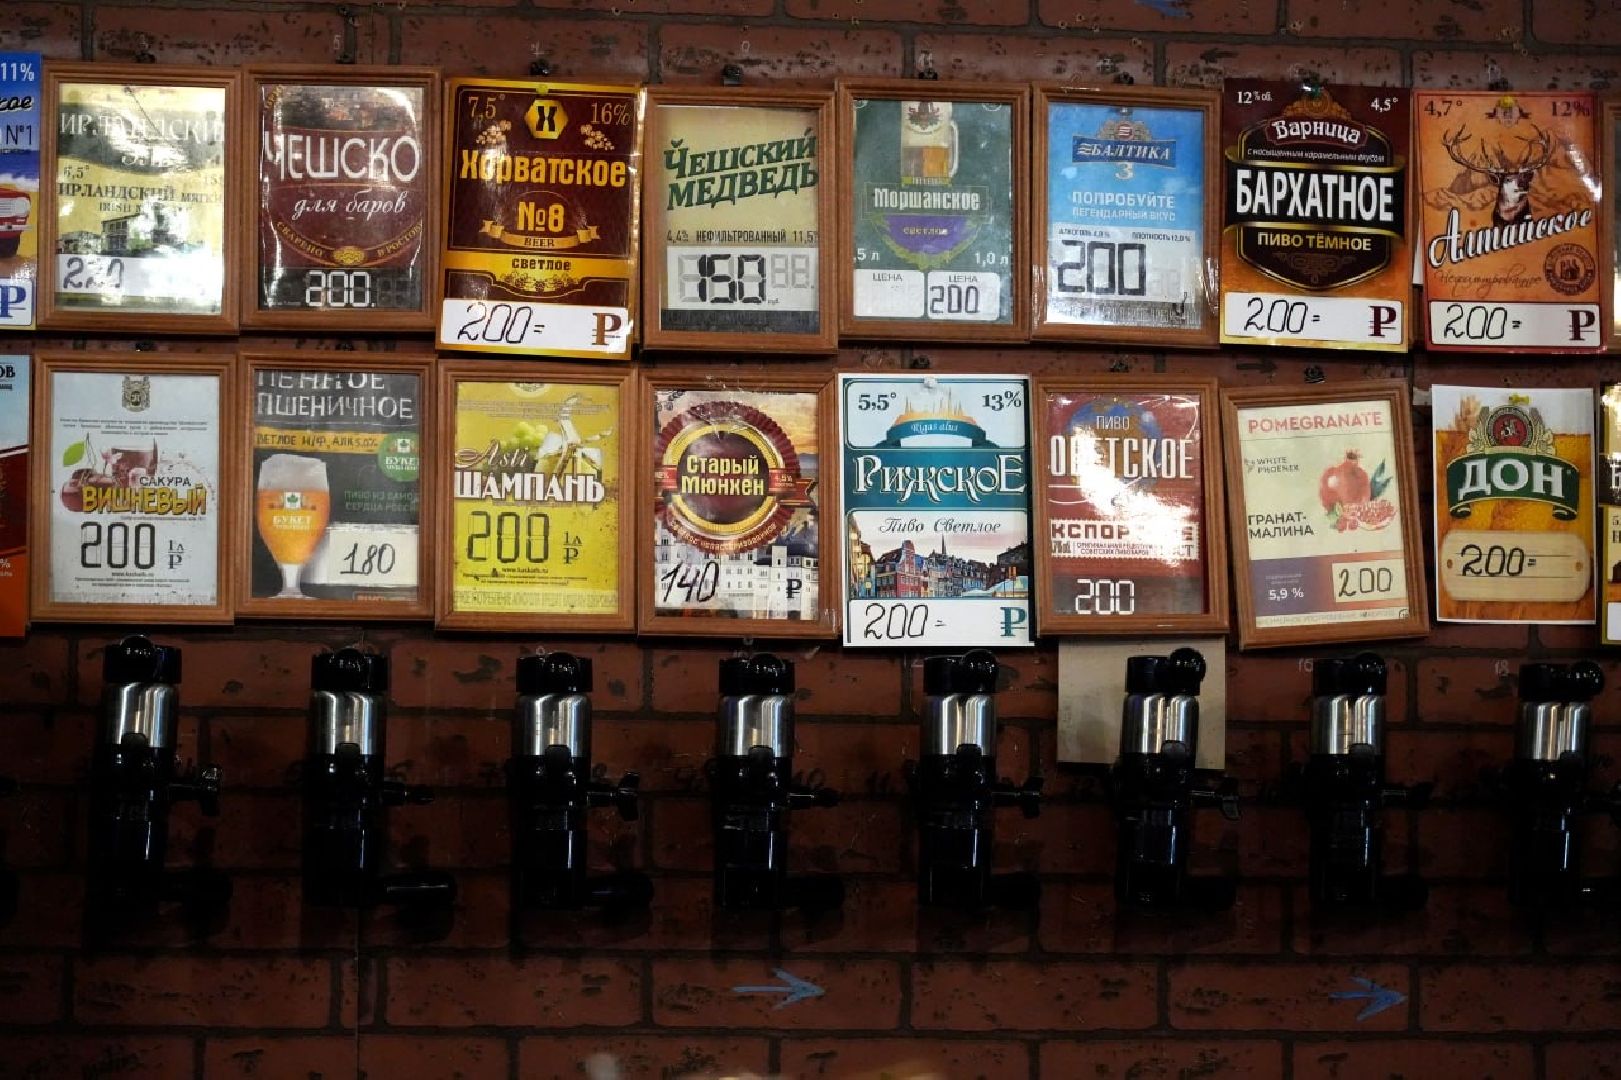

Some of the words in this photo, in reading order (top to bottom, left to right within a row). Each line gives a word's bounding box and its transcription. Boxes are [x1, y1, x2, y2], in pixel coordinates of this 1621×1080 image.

[590, 101, 632, 126] 16%
[1423, 100, 1463, 117] 4,7°
[1551, 101, 1590, 117] 12%
[1272, 119, 1361, 144] Варница
[1090, 144, 1170, 161] БАЛТИКА
[460, 149, 626, 188] Хорватское
[1115, 162, 1135, 180] 3
[666, 162, 819, 211] МЕДВЕДЬ
[1236, 169, 1394, 222] БАРХАТНОЕ
[291, 198, 338, 221] для
[345, 190, 408, 222] баров
[874, 187, 982, 211] Моршанское
[1072, 191, 1176, 209] ПОПРОБУЙТЕ
[523, 236, 555, 247] BEER
[696, 229, 787, 243] НЕФИЛЬТРОВАННЫЙ
[1257, 232, 1303, 246] ПИВО
[1306, 234, 1372, 251] ТЁМНОЕ
[699, 254, 767, 304] 150
[872, 272, 903, 283] ЦЕНА
[949, 275, 978, 284] ЦЕНА
[1057, 239, 1147, 297] 200
[929, 285, 981, 314] 200
[257, 393, 413, 420] ПШЕНИЧНОЕ
[858, 391, 897, 411] 5,5°
[981, 390, 1022, 412] 13%
[1096, 415, 1130, 430] ПИВО
[1247, 411, 1383, 434] POMEGRANATE
[686, 454, 759, 477] Старый
[1257, 456, 1287, 465] WHITE
[139, 476, 191, 487] САКУРА
[454, 471, 605, 502] ШАМПАНЬ
[681, 475, 764, 496] Мюнхен
[1457, 458, 1565, 502] ДОН
[81, 483, 207, 516] ВИШНЕВЫЙ
[467, 510, 549, 563] 200
[879, 518, 924, 533] Пиво
[933, 518, 1001, 534] Светлое
[1249, 524, 1314, 540] МАЛИНА
[80, 521, 156, 569] 200
[340, 543, 396, 576] 180
[661, 561, 719, 602] 140
[1338, 567, 1393, 598] 200
[1075, 578, 1135, 615] 200
[1269, 588, 1288, 601] 5,9
[1291, 587, 1304, 598] %
